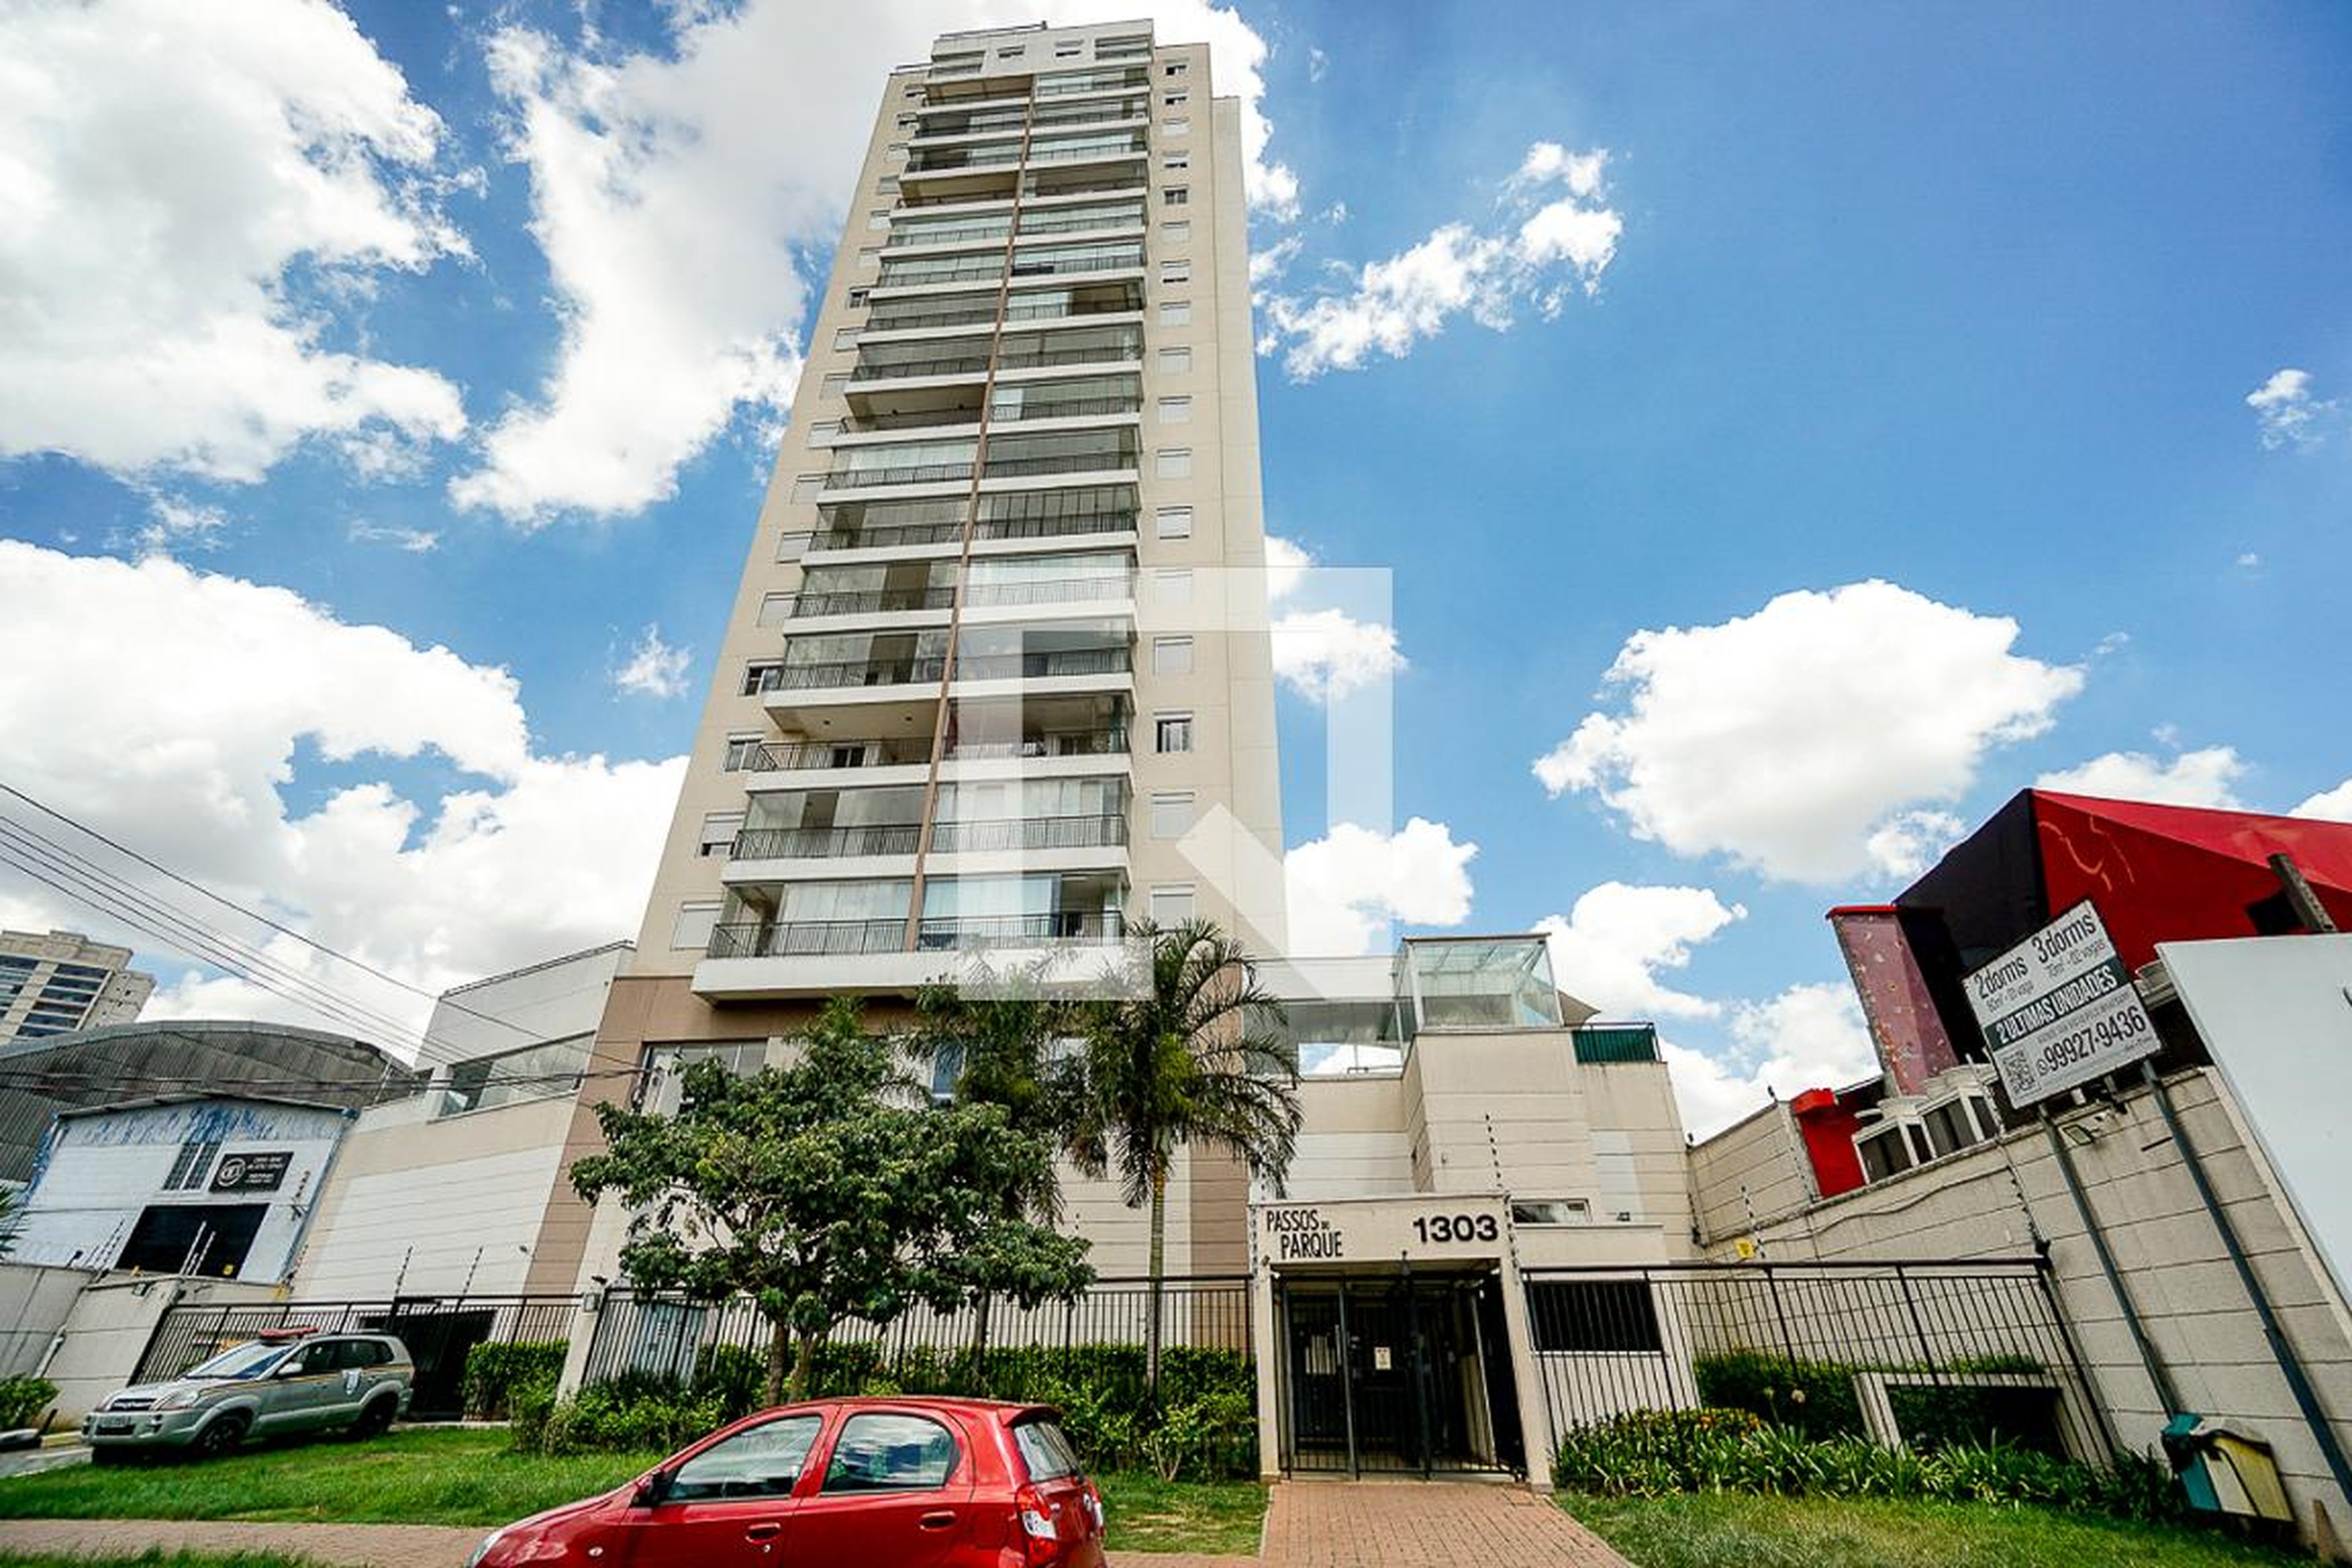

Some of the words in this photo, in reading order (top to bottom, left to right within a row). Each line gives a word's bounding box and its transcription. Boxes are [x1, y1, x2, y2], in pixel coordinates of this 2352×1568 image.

[2032, 914, 2096, 963] 3dorms
[1974, 957, 2028, 999] 2dorms
[2049, 965, 2117, 1016] UNIDADES
[1267, 1209, 1319, 1232] PASSOS
[1412, 1214, 1499, 1243] 1303
[1281, 1231, 1343, 1260] PARQUE
